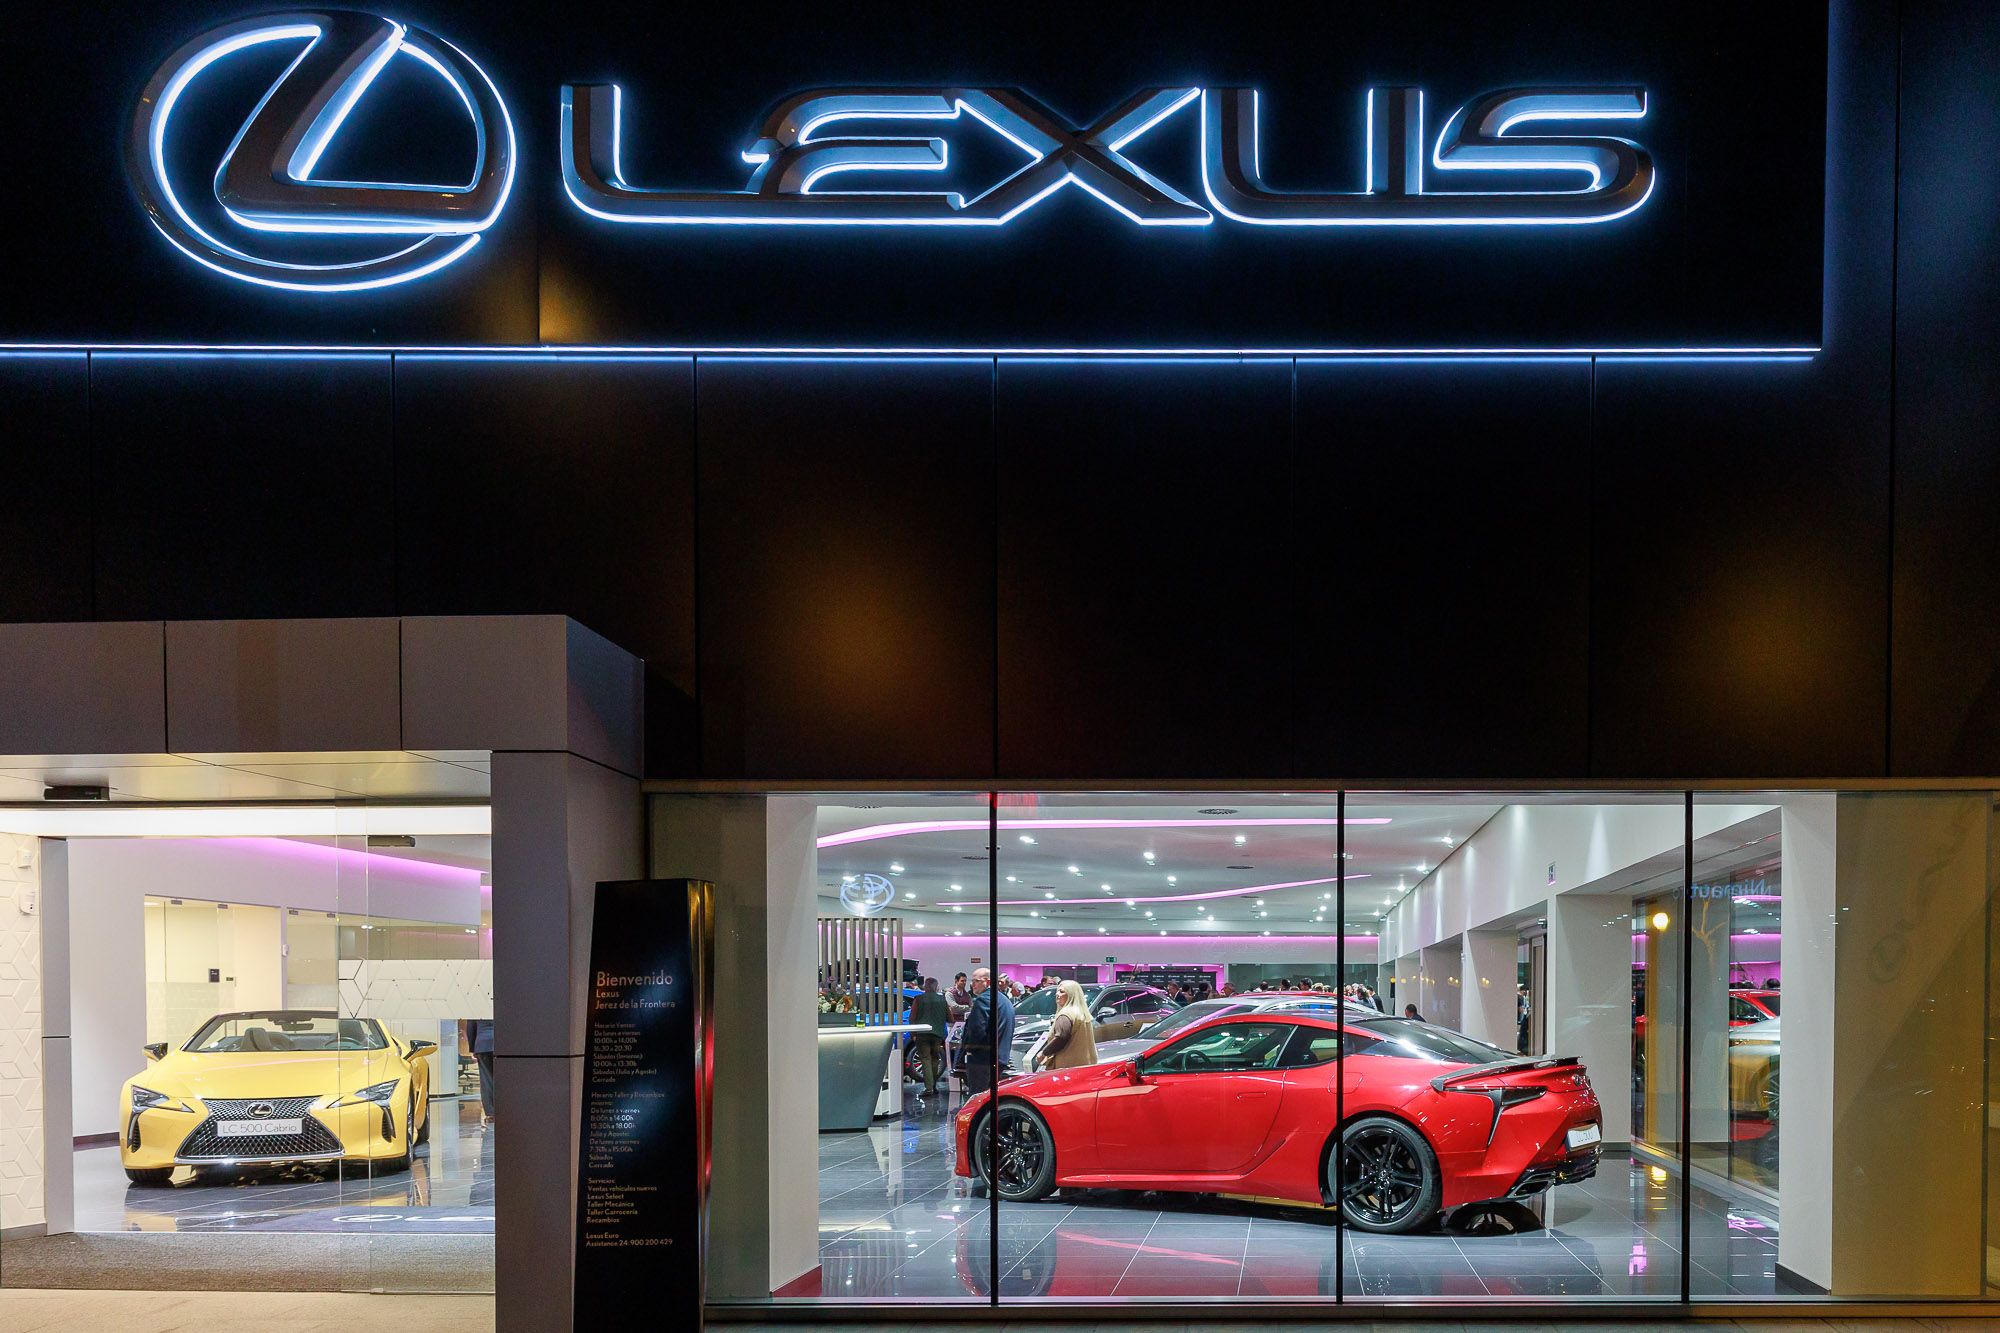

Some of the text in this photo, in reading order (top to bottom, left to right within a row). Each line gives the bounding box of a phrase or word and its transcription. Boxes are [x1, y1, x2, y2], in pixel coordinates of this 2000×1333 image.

[560, 84, 1656, 227] LEXUS
[597, 970, 673, 986] Bienvenido
[595, 999, 675, 1010] Jerez de la Frontera
[240, 1124, 262, 1133] 500
[264, 1122, 297, 1132] Cabrio
